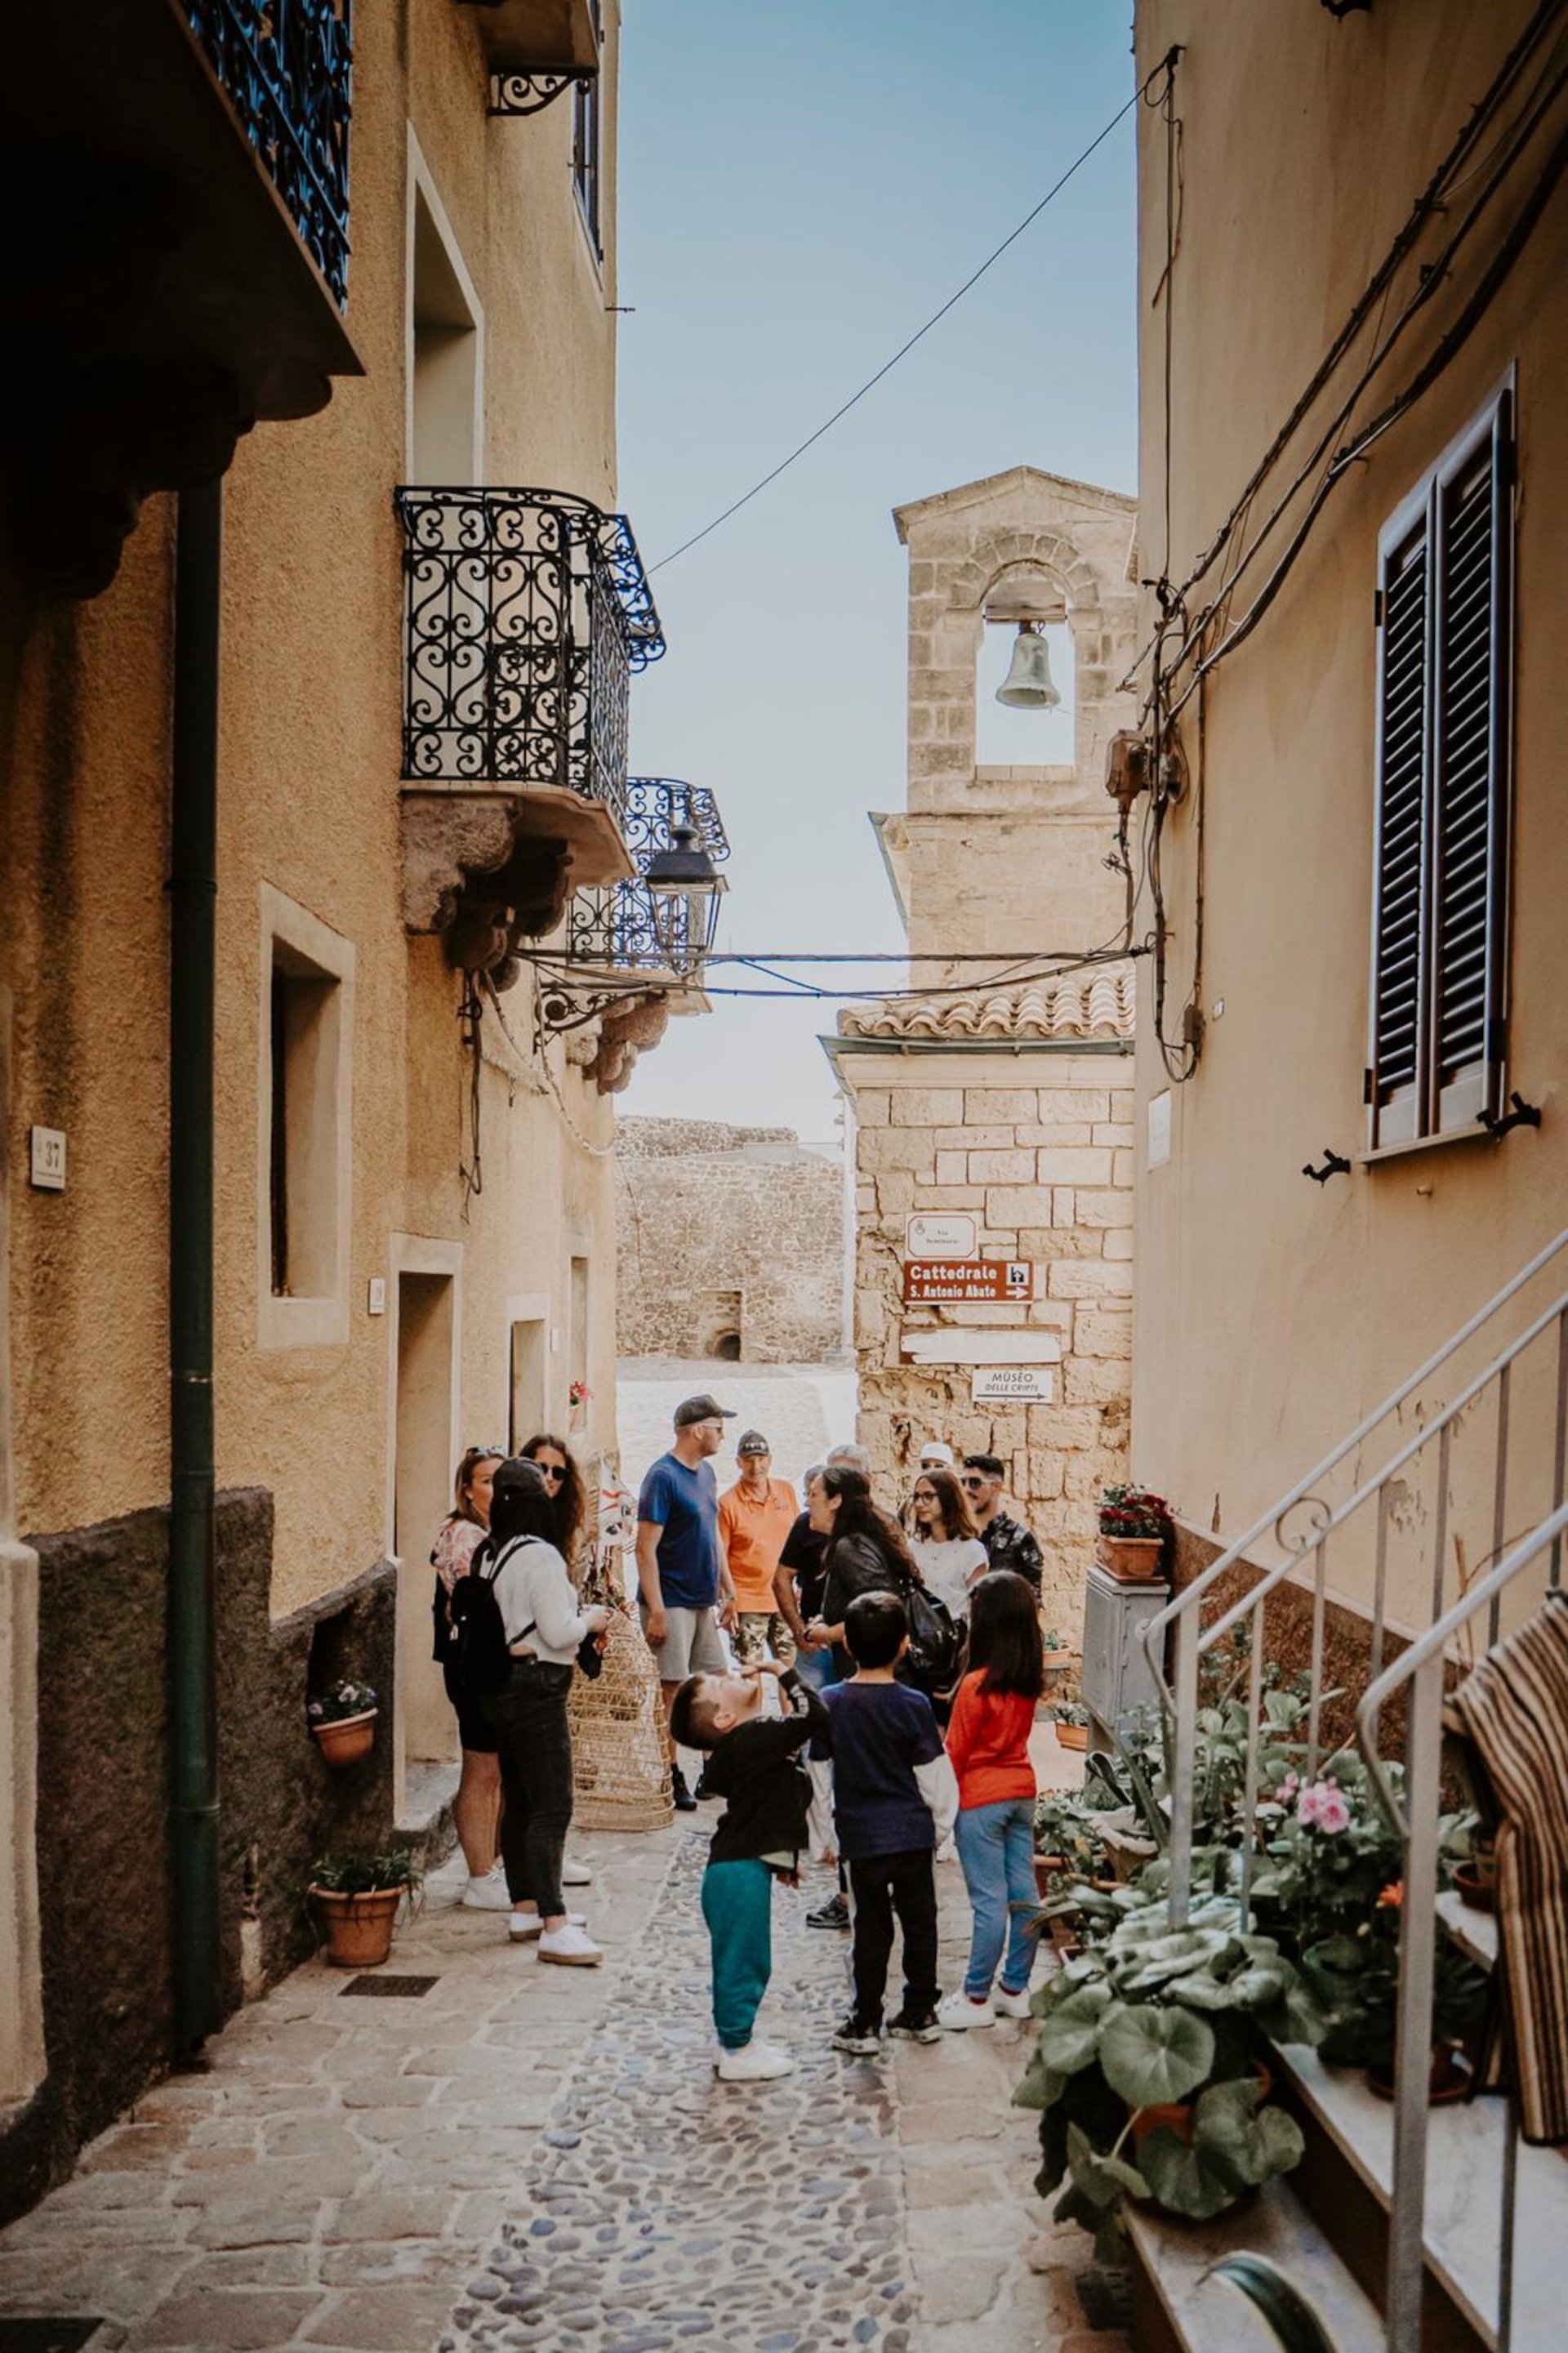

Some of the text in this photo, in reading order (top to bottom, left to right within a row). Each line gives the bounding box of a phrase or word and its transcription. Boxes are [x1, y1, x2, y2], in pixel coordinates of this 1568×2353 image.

[45, 1140, 60, 1169] 37
[910, 1264, 998, 1281] Cattedrale
[910, 1284, 997, 1298] S. Antonio Abate
[985, 1384, 1009, 1392] DELLE
